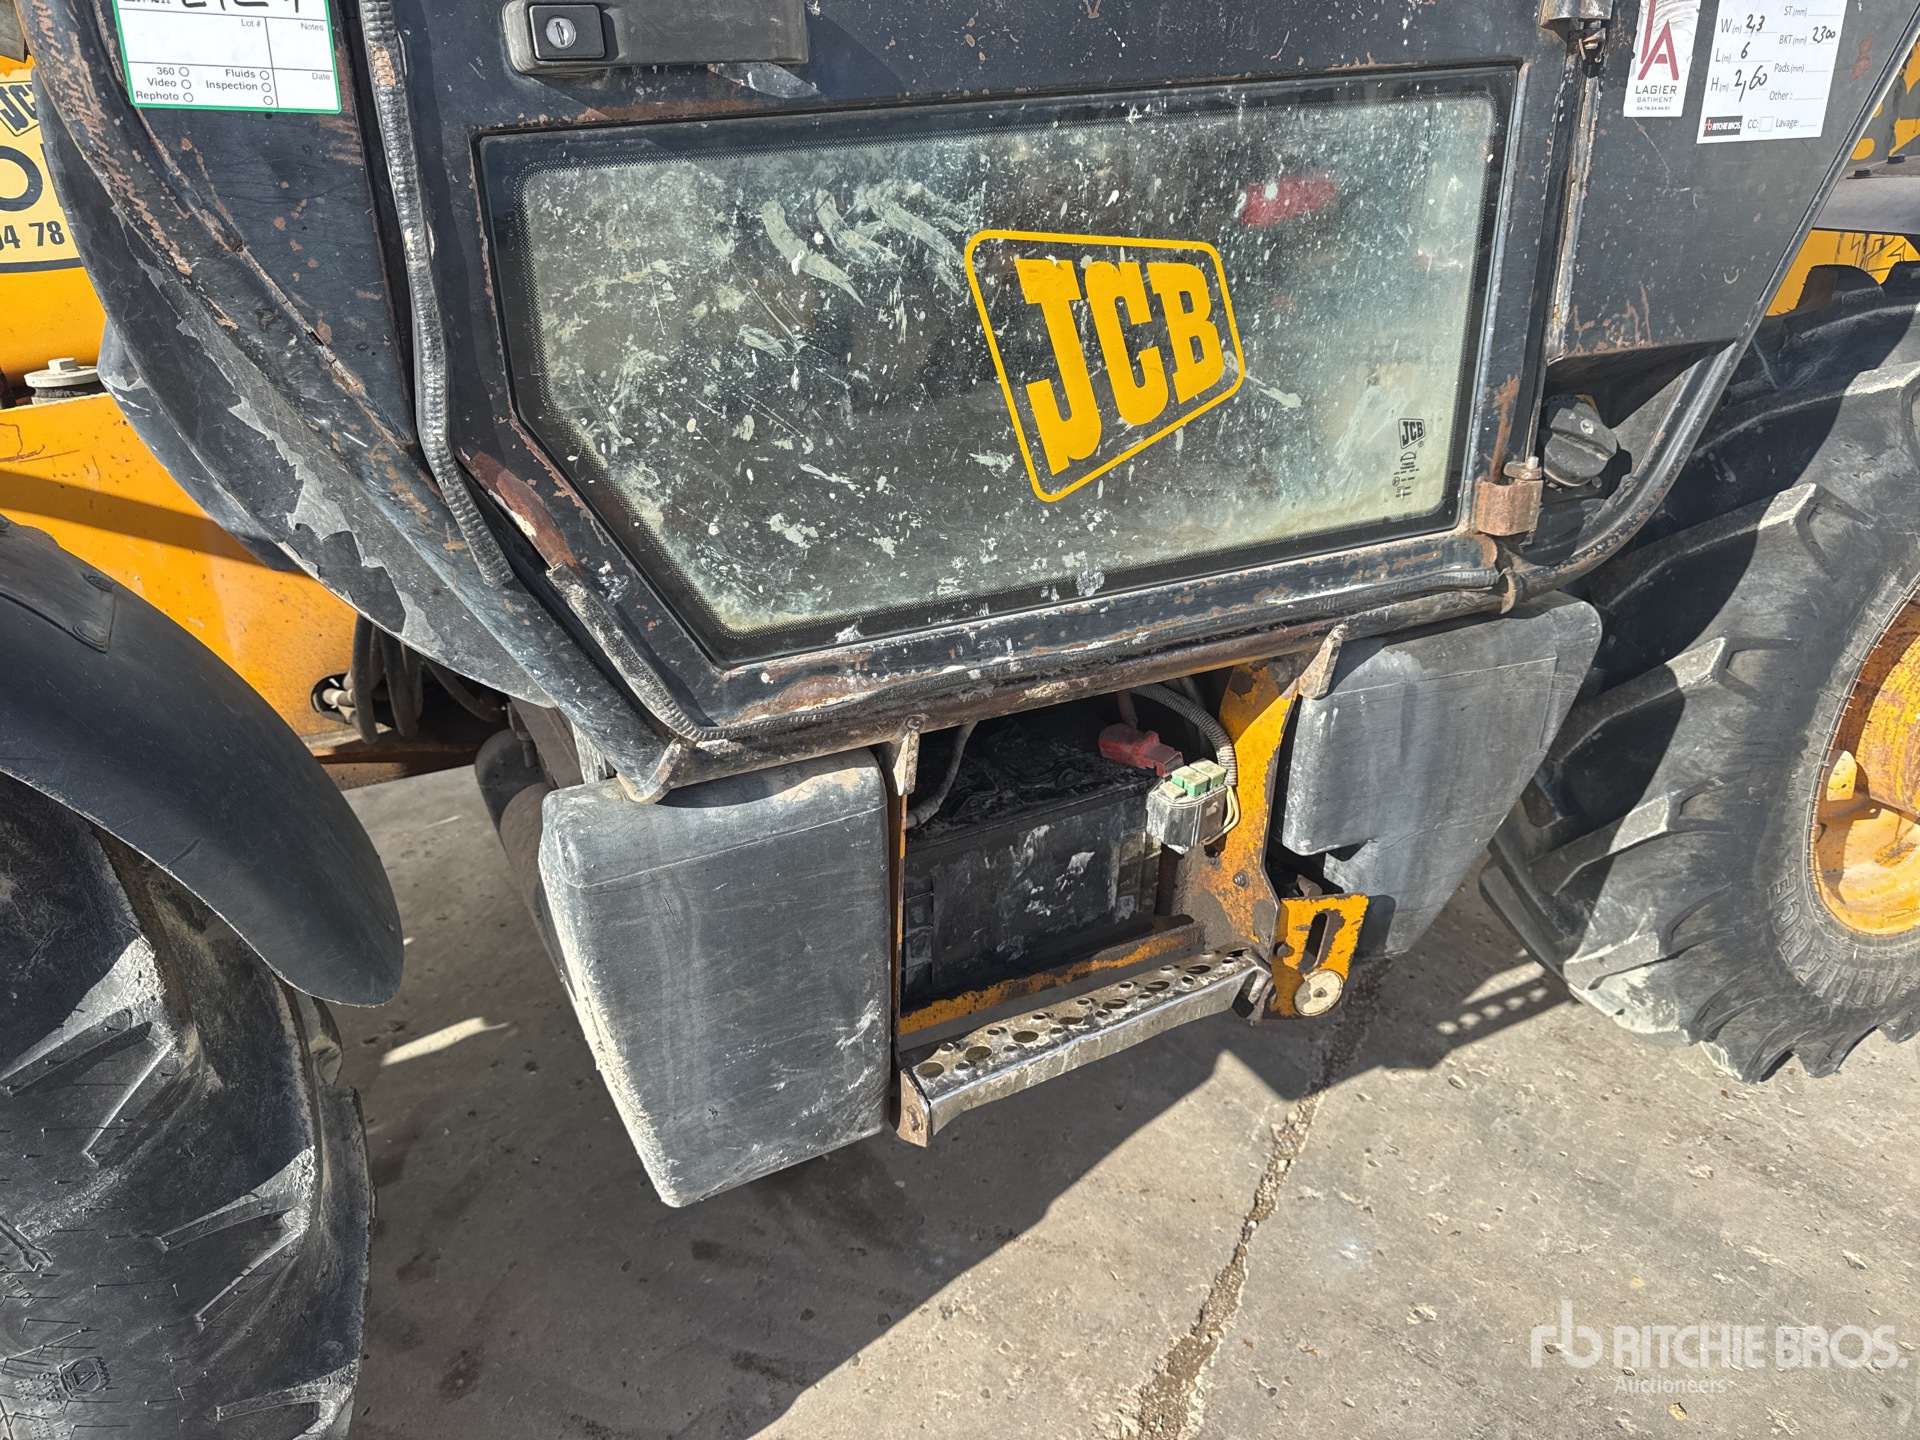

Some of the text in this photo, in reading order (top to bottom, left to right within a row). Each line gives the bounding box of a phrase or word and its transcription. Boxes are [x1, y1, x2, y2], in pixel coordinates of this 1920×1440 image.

[241, 19, 254, 28] Lot
[301, 22, 324, 32] Notes
[1812, 26, 1836, 44] 2300
[1741, 42, 1750, 59] 6
[157, 67, 174, 76] 360
[225, 69, 256, 78] Fluids
[312, 72, 330, 81] Date
[147, 77, 176, 88] Video
[206, 80, 258, 92] Inspection
[1735, 65, 1767, 102] 2,60
[1635, 85, 1677, 94] LAGIER
[136, 90, 179, 102] Rephoto
[29, 221, 65, 247] 78
[1015, 258, 1224, 476] JCB
[1402, 421, 1424, 446] JCB
